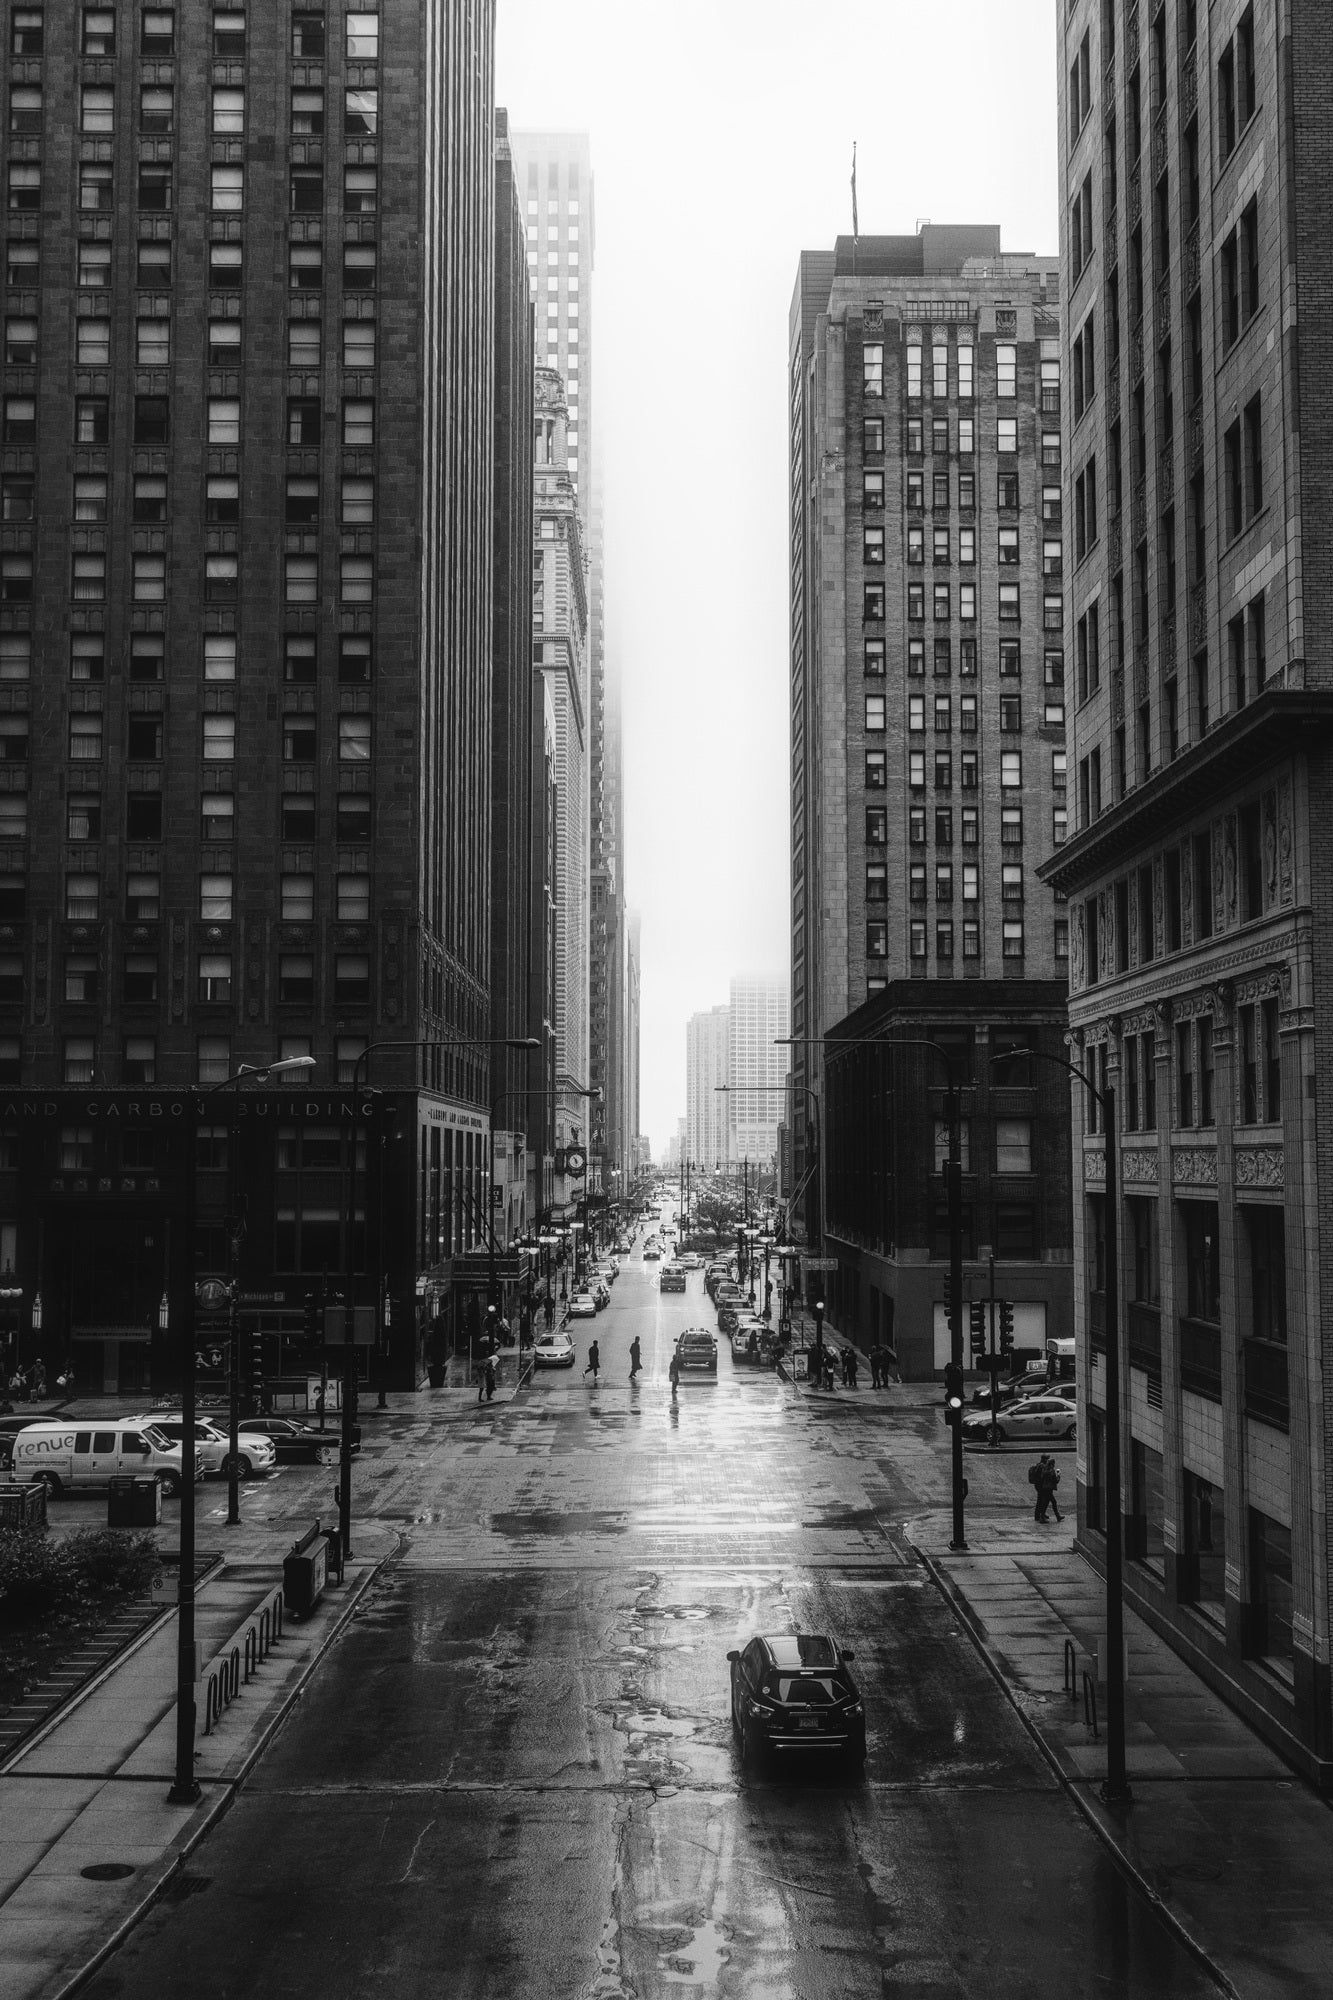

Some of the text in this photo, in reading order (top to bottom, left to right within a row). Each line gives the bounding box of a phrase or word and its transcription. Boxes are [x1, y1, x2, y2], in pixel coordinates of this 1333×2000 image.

[4, 1103, 374, 1116] AND CARBON BUILDING
[17, 1435, 75, 1458] renue
